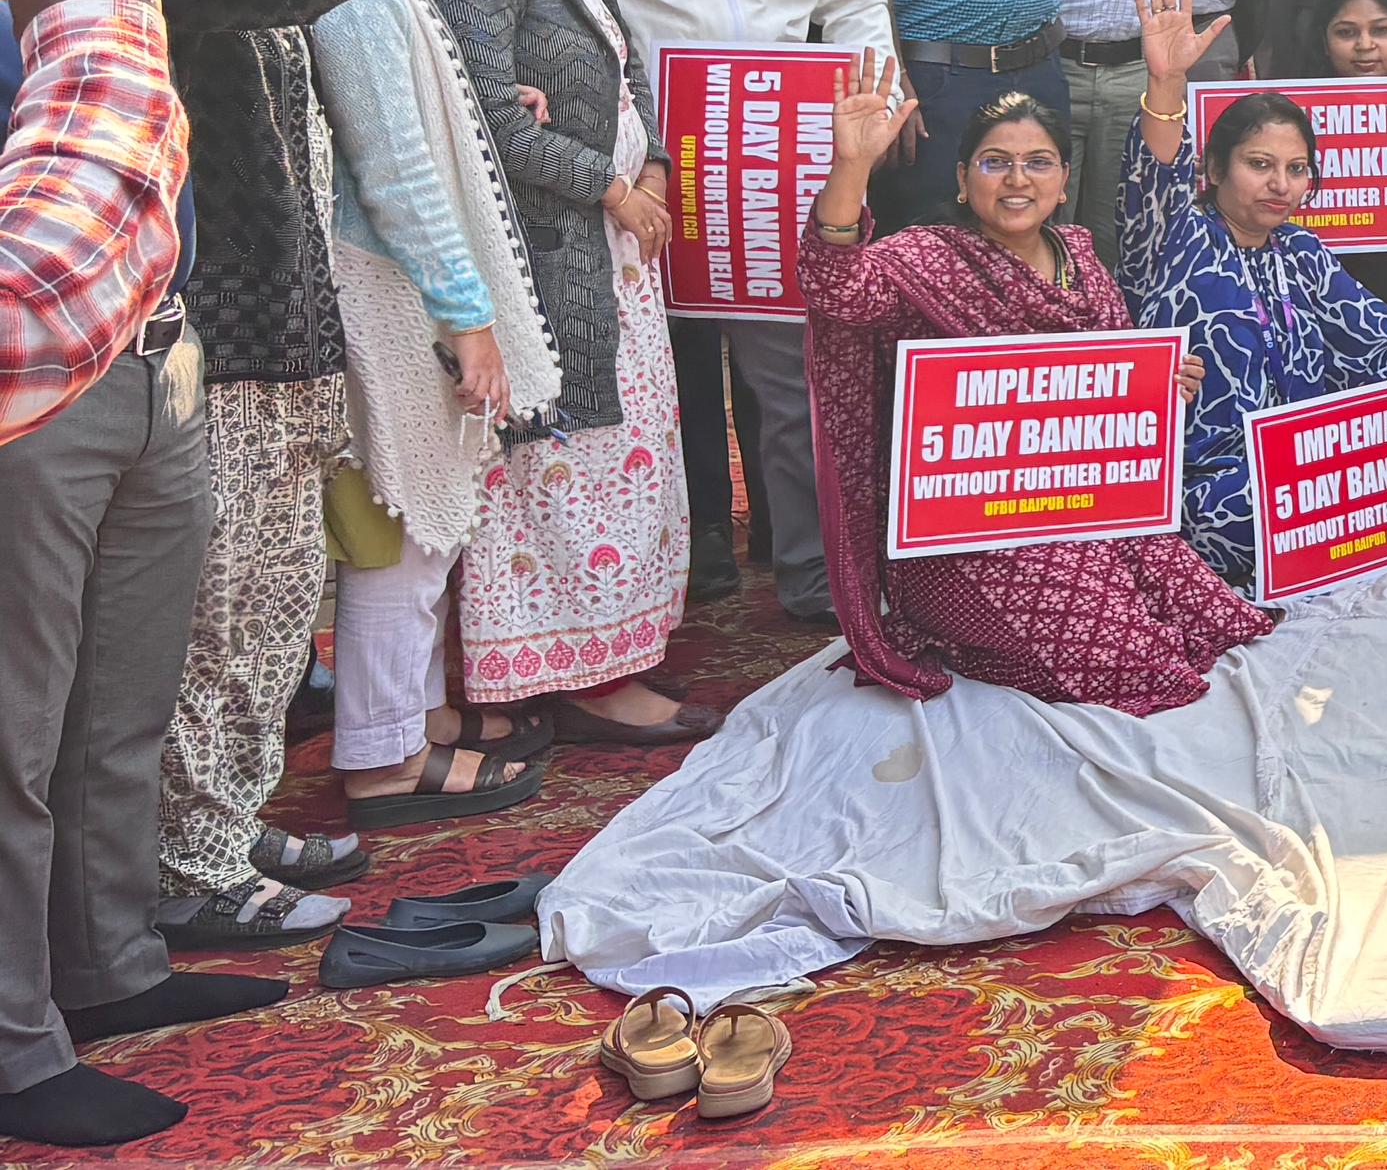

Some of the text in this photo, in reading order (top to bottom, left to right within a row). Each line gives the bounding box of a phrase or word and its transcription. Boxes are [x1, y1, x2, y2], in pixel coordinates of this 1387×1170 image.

[680, 170, 697, 214] RAIPUR
[703, 63, 735, 302] WITHOUT FURTHER DELAY
[742, 70, 784, 299] 5 DAY BANKING
[956, 362, 1134, 407] IMPLEMENT
[922, 411, 1157, 462] 5 DAY BANKING
[913, 458, 1162, 499] WITHOUT FURTHER DELAY
[1275, 485, 1293, 519] 5
[1298, 470, 1341, 513] DAY
[1019, 496, 1064, 513] RAIPUR
[1273, 515, 1345, 554] WITHOUT
[1354, 531, 1386, 552] RAIPUR
